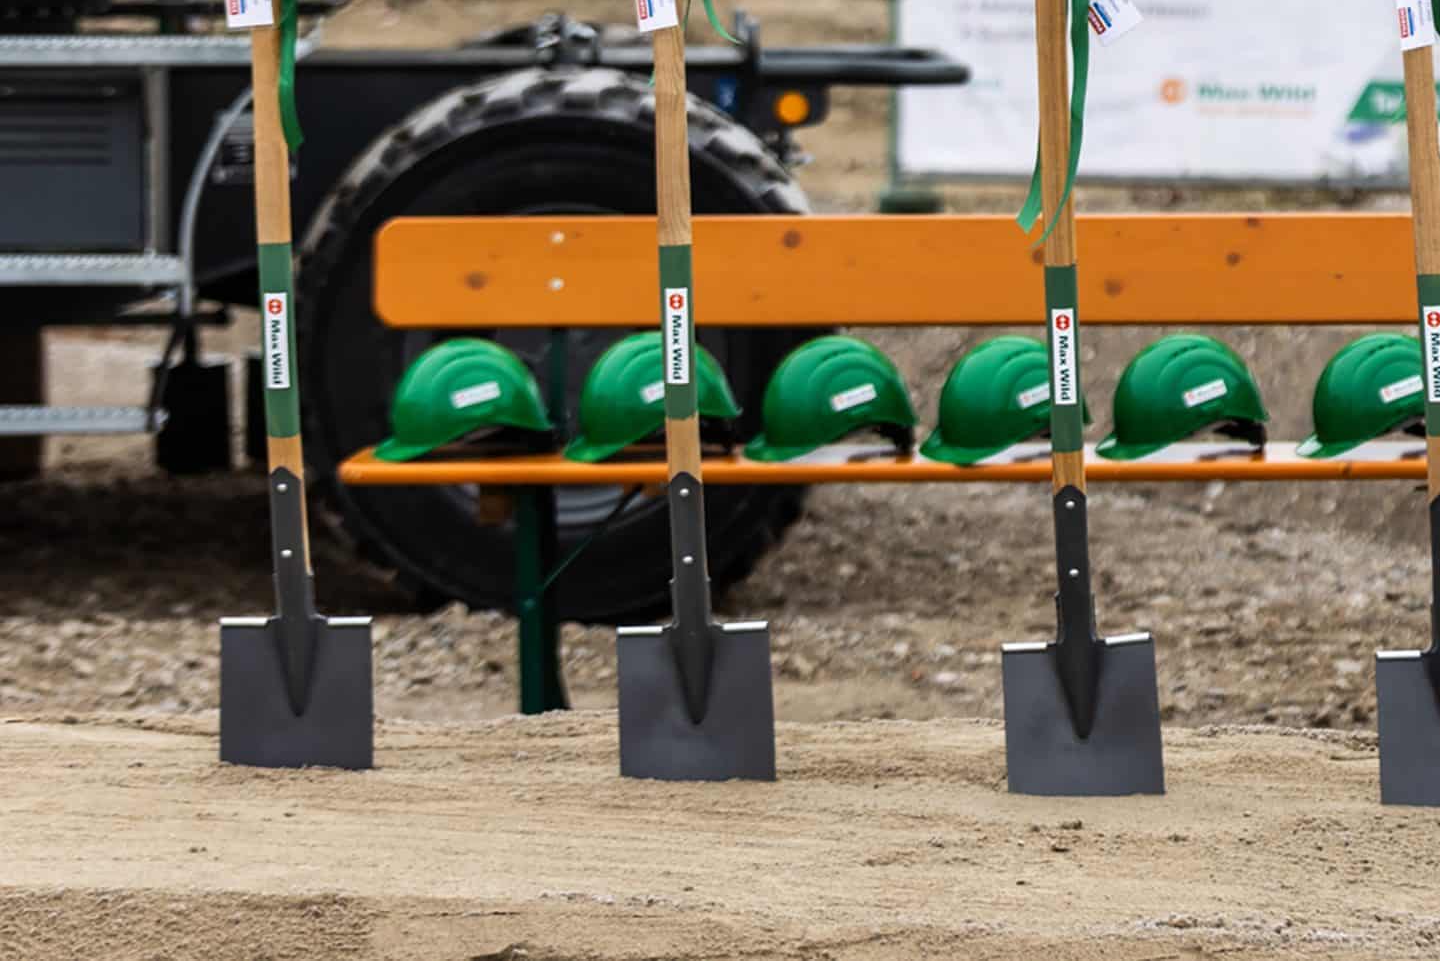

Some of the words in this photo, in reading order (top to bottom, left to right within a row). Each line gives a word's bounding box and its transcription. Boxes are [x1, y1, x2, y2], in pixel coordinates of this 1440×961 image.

[271, 320, 281, 349] Max
[672, 315, 682, 344] Max
[1059, 335, 1069, 366] Max
[1431, 333, 1440, 363] Max
[272, 353, 283, 384] Wild
[673, 348, 683, 380] Wild
[1060, 369, 1071, 400] Wild
